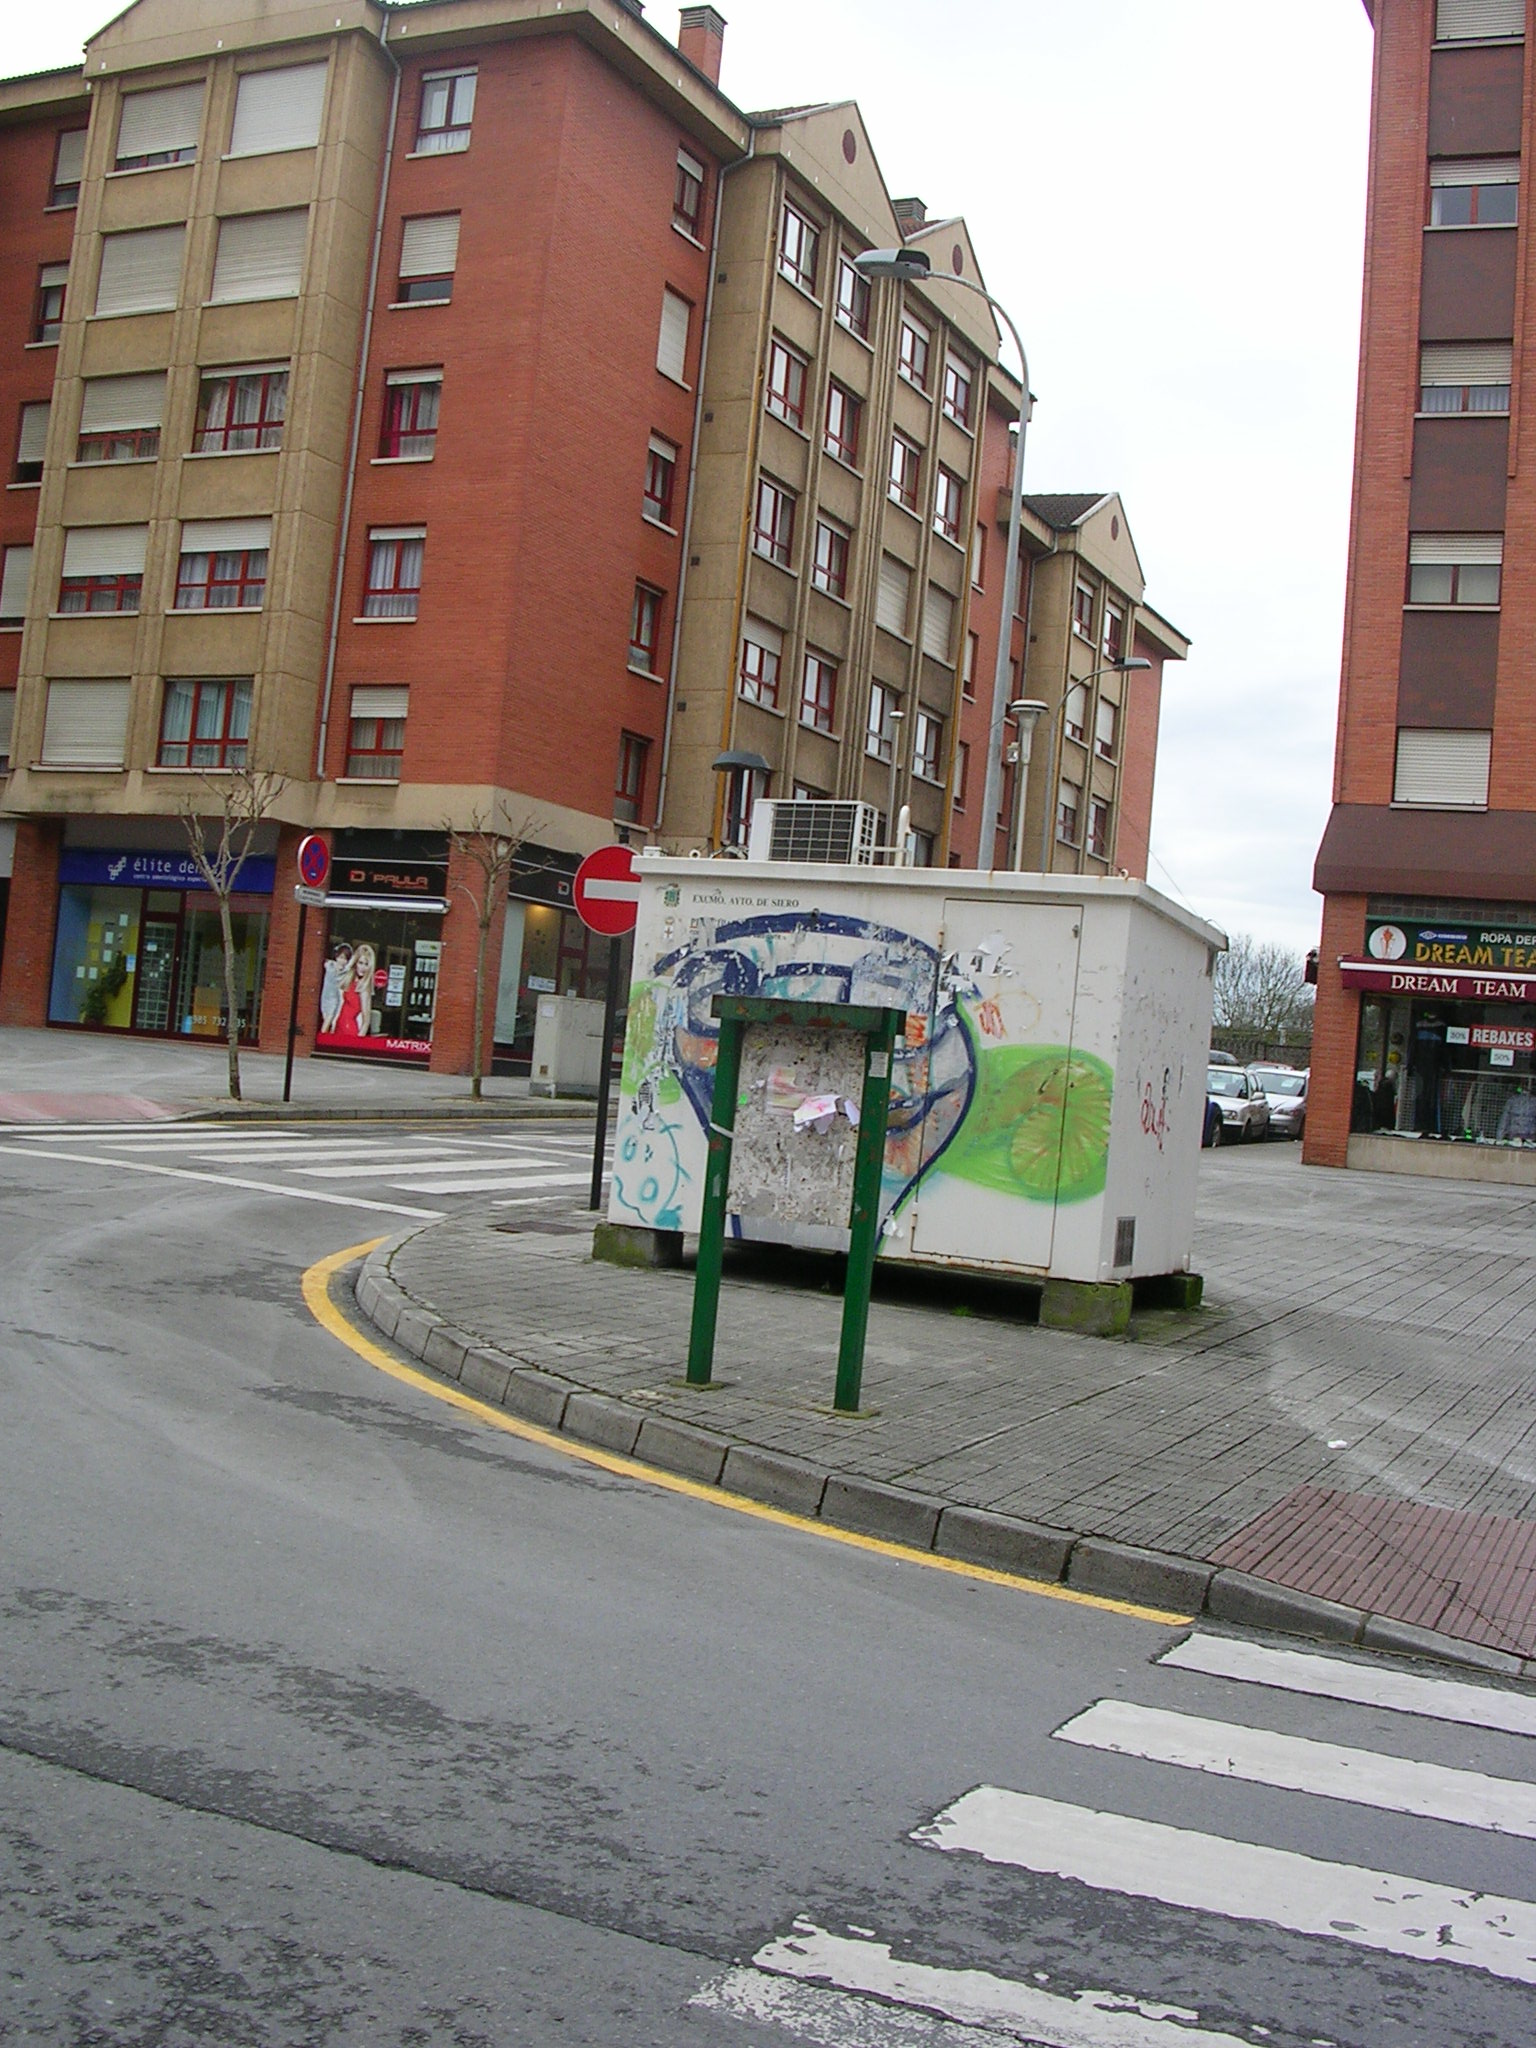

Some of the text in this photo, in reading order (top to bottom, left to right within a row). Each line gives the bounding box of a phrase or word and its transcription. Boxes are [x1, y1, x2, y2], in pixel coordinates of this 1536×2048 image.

[133, 857, 171, 873] élite
[756, 899, 768, 907] DE
[771, 899, 800, 908] SIERO
[1480, 932, 1513, 945] ROPA
[1415, 942, 1494, 966] DREAM
[1391, 974, 1527, 998] DREAM TEAM
[386, 1039, 432, 1052] MATRIX
[1472, 1028, 1534, 1047] REBAXES
